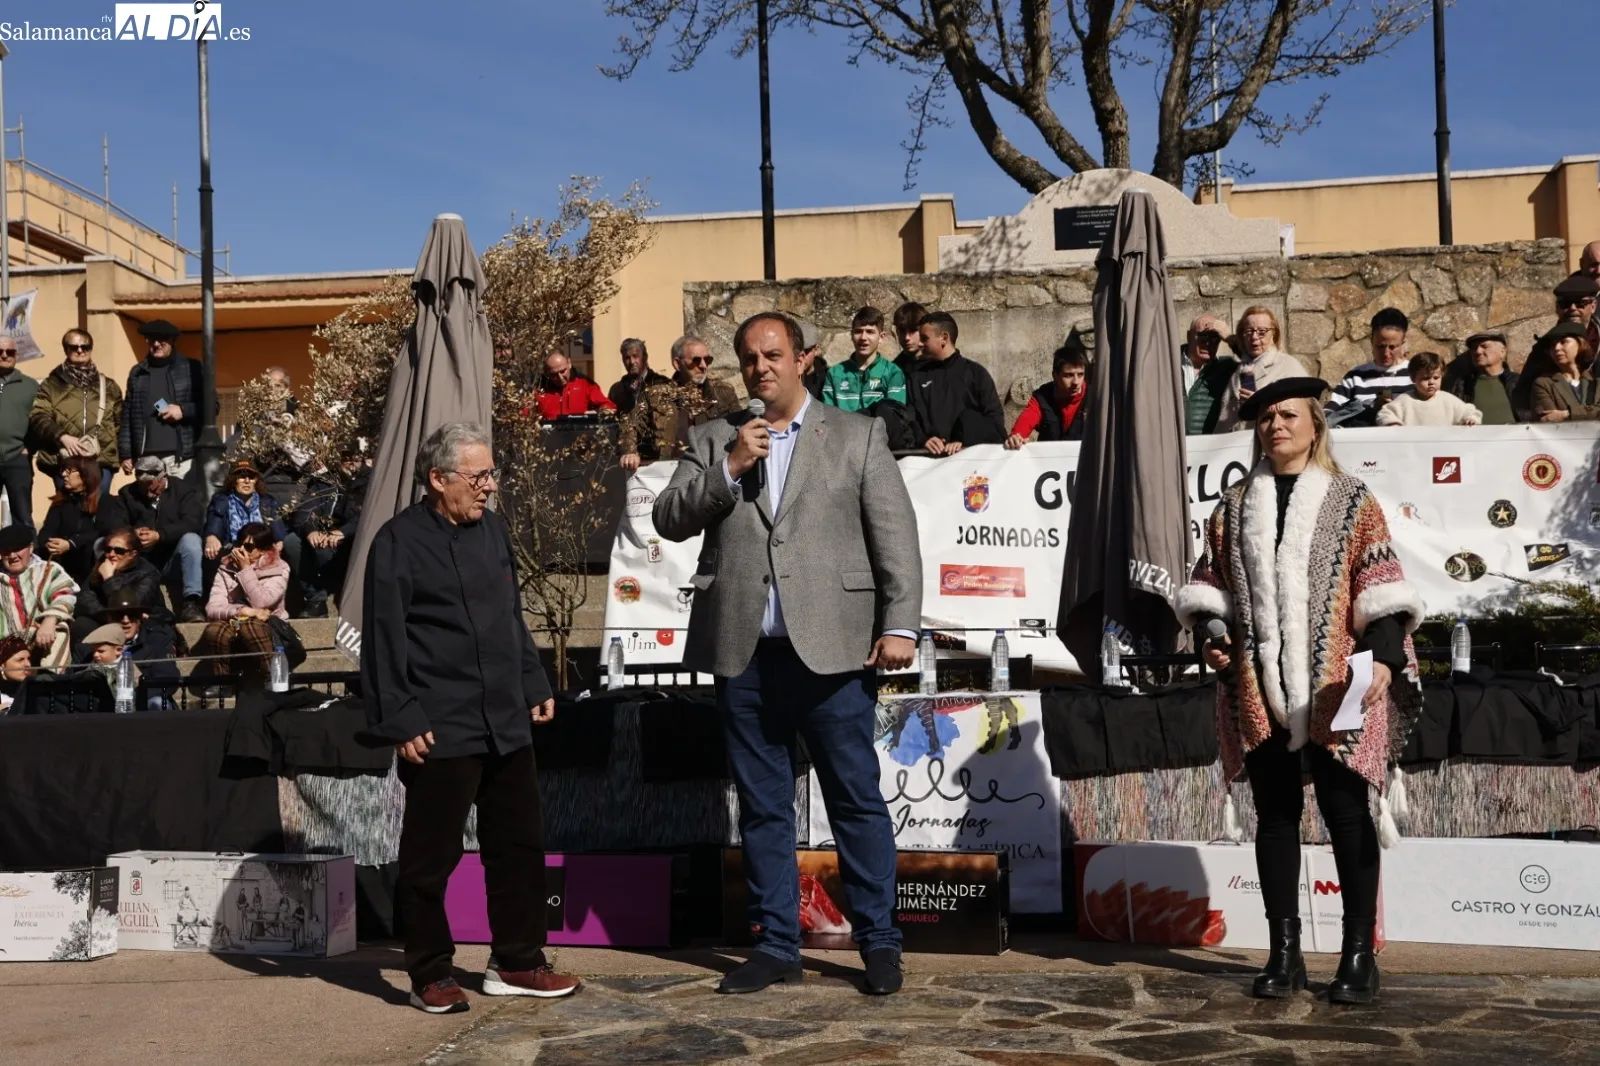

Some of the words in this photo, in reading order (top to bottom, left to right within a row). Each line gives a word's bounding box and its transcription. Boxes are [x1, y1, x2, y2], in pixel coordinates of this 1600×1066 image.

[956, 524, 1061, 548] JORNADAS
[893, 803, 992, 838] Jornadas
[897, 880, 987, 898] HERNÁNDEZ
[896, 895, 958, 911] JIMÉNEZ
[1451, 900, 1516, 914] CASTRO
[1520, 903, 1531, 915] Y
[897, 913, 940, 923] GUIJUELO
